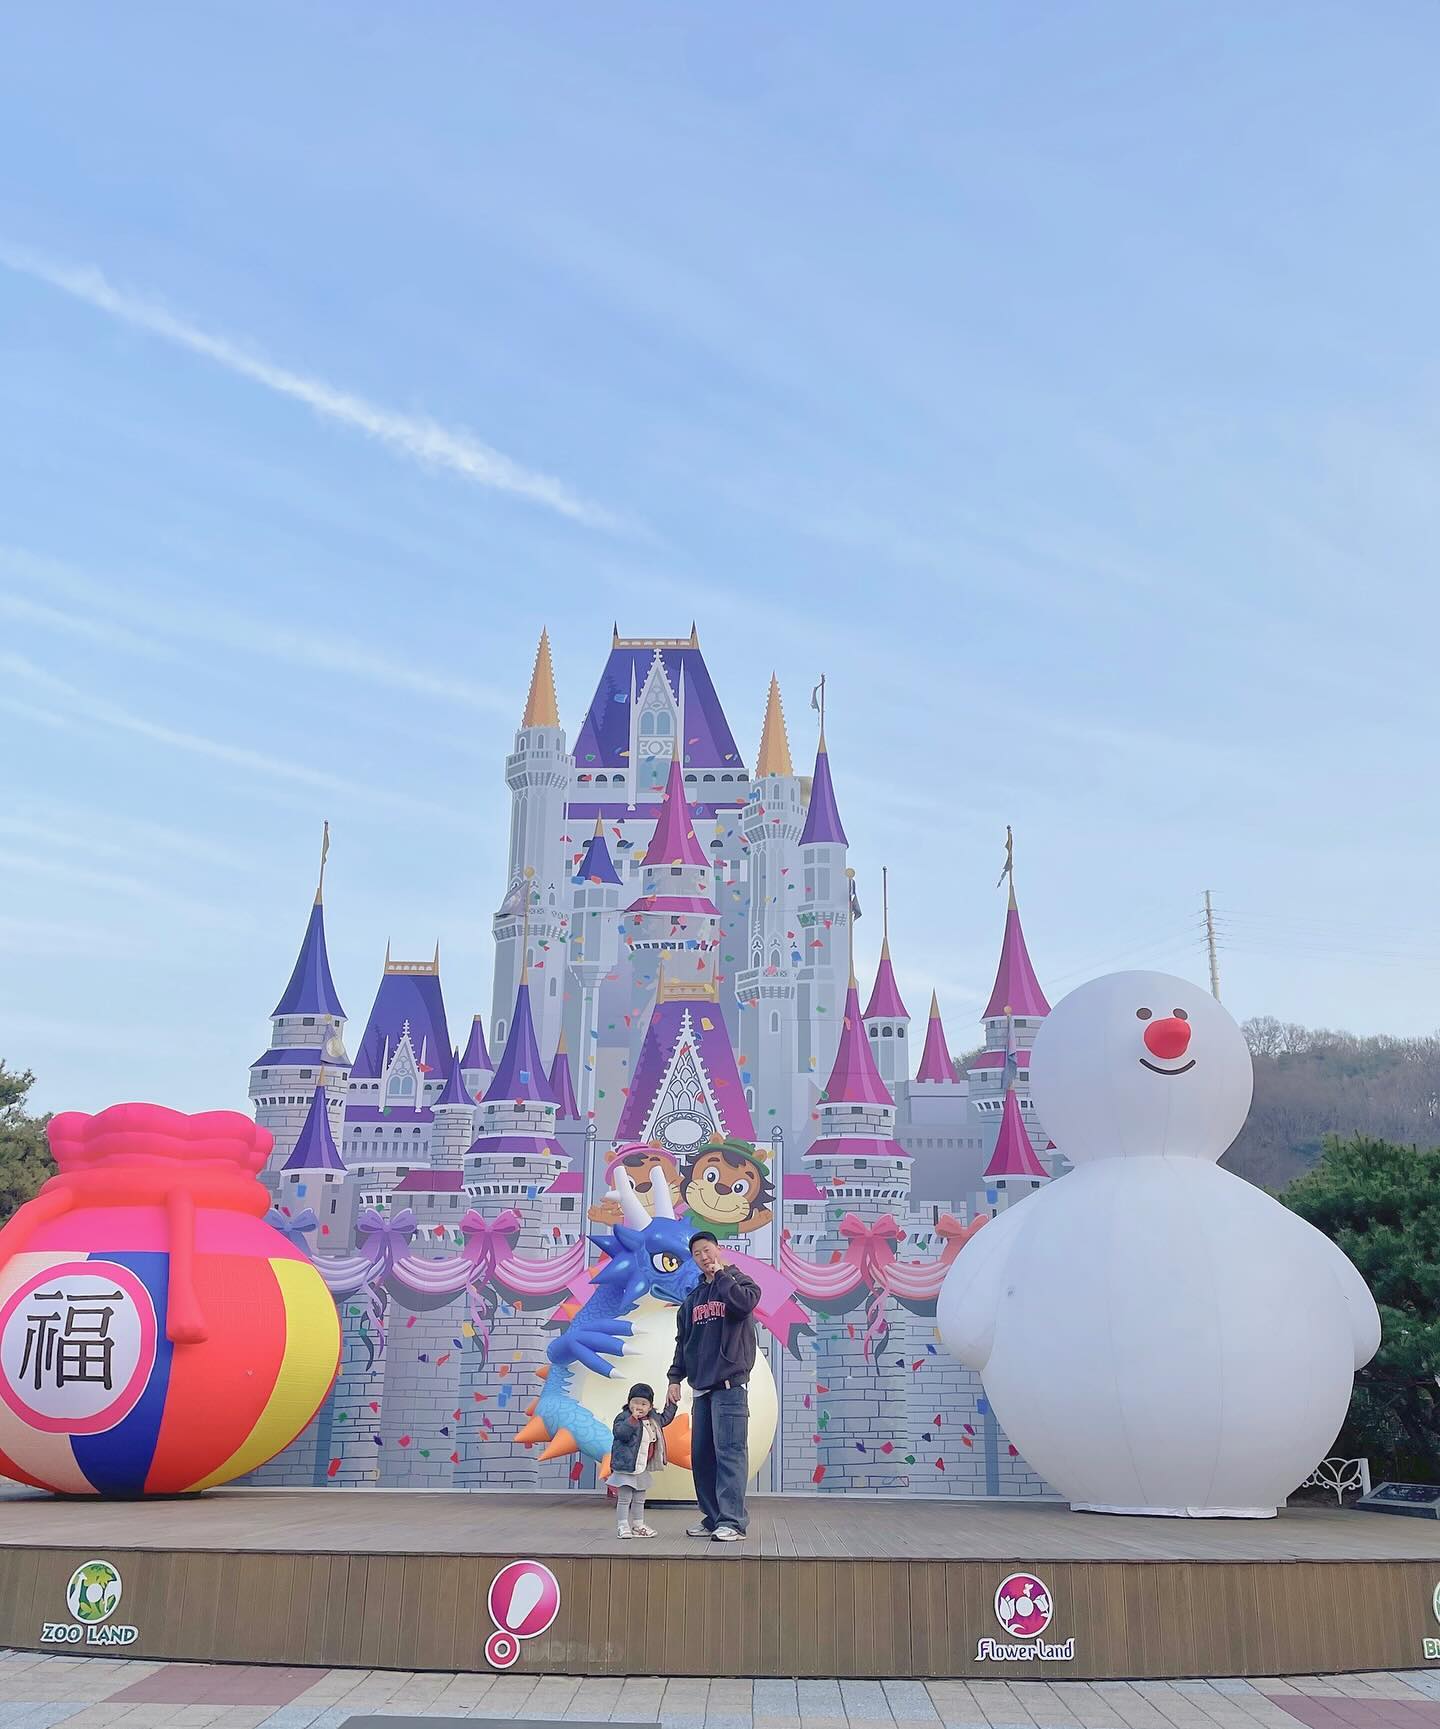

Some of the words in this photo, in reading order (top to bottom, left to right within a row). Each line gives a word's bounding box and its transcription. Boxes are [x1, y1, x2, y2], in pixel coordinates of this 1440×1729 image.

[19, 1290, 124, 1391] 福
[42, 1624, 82, 1642] ZOO
[87, 1626, 137, 1644] LAND
